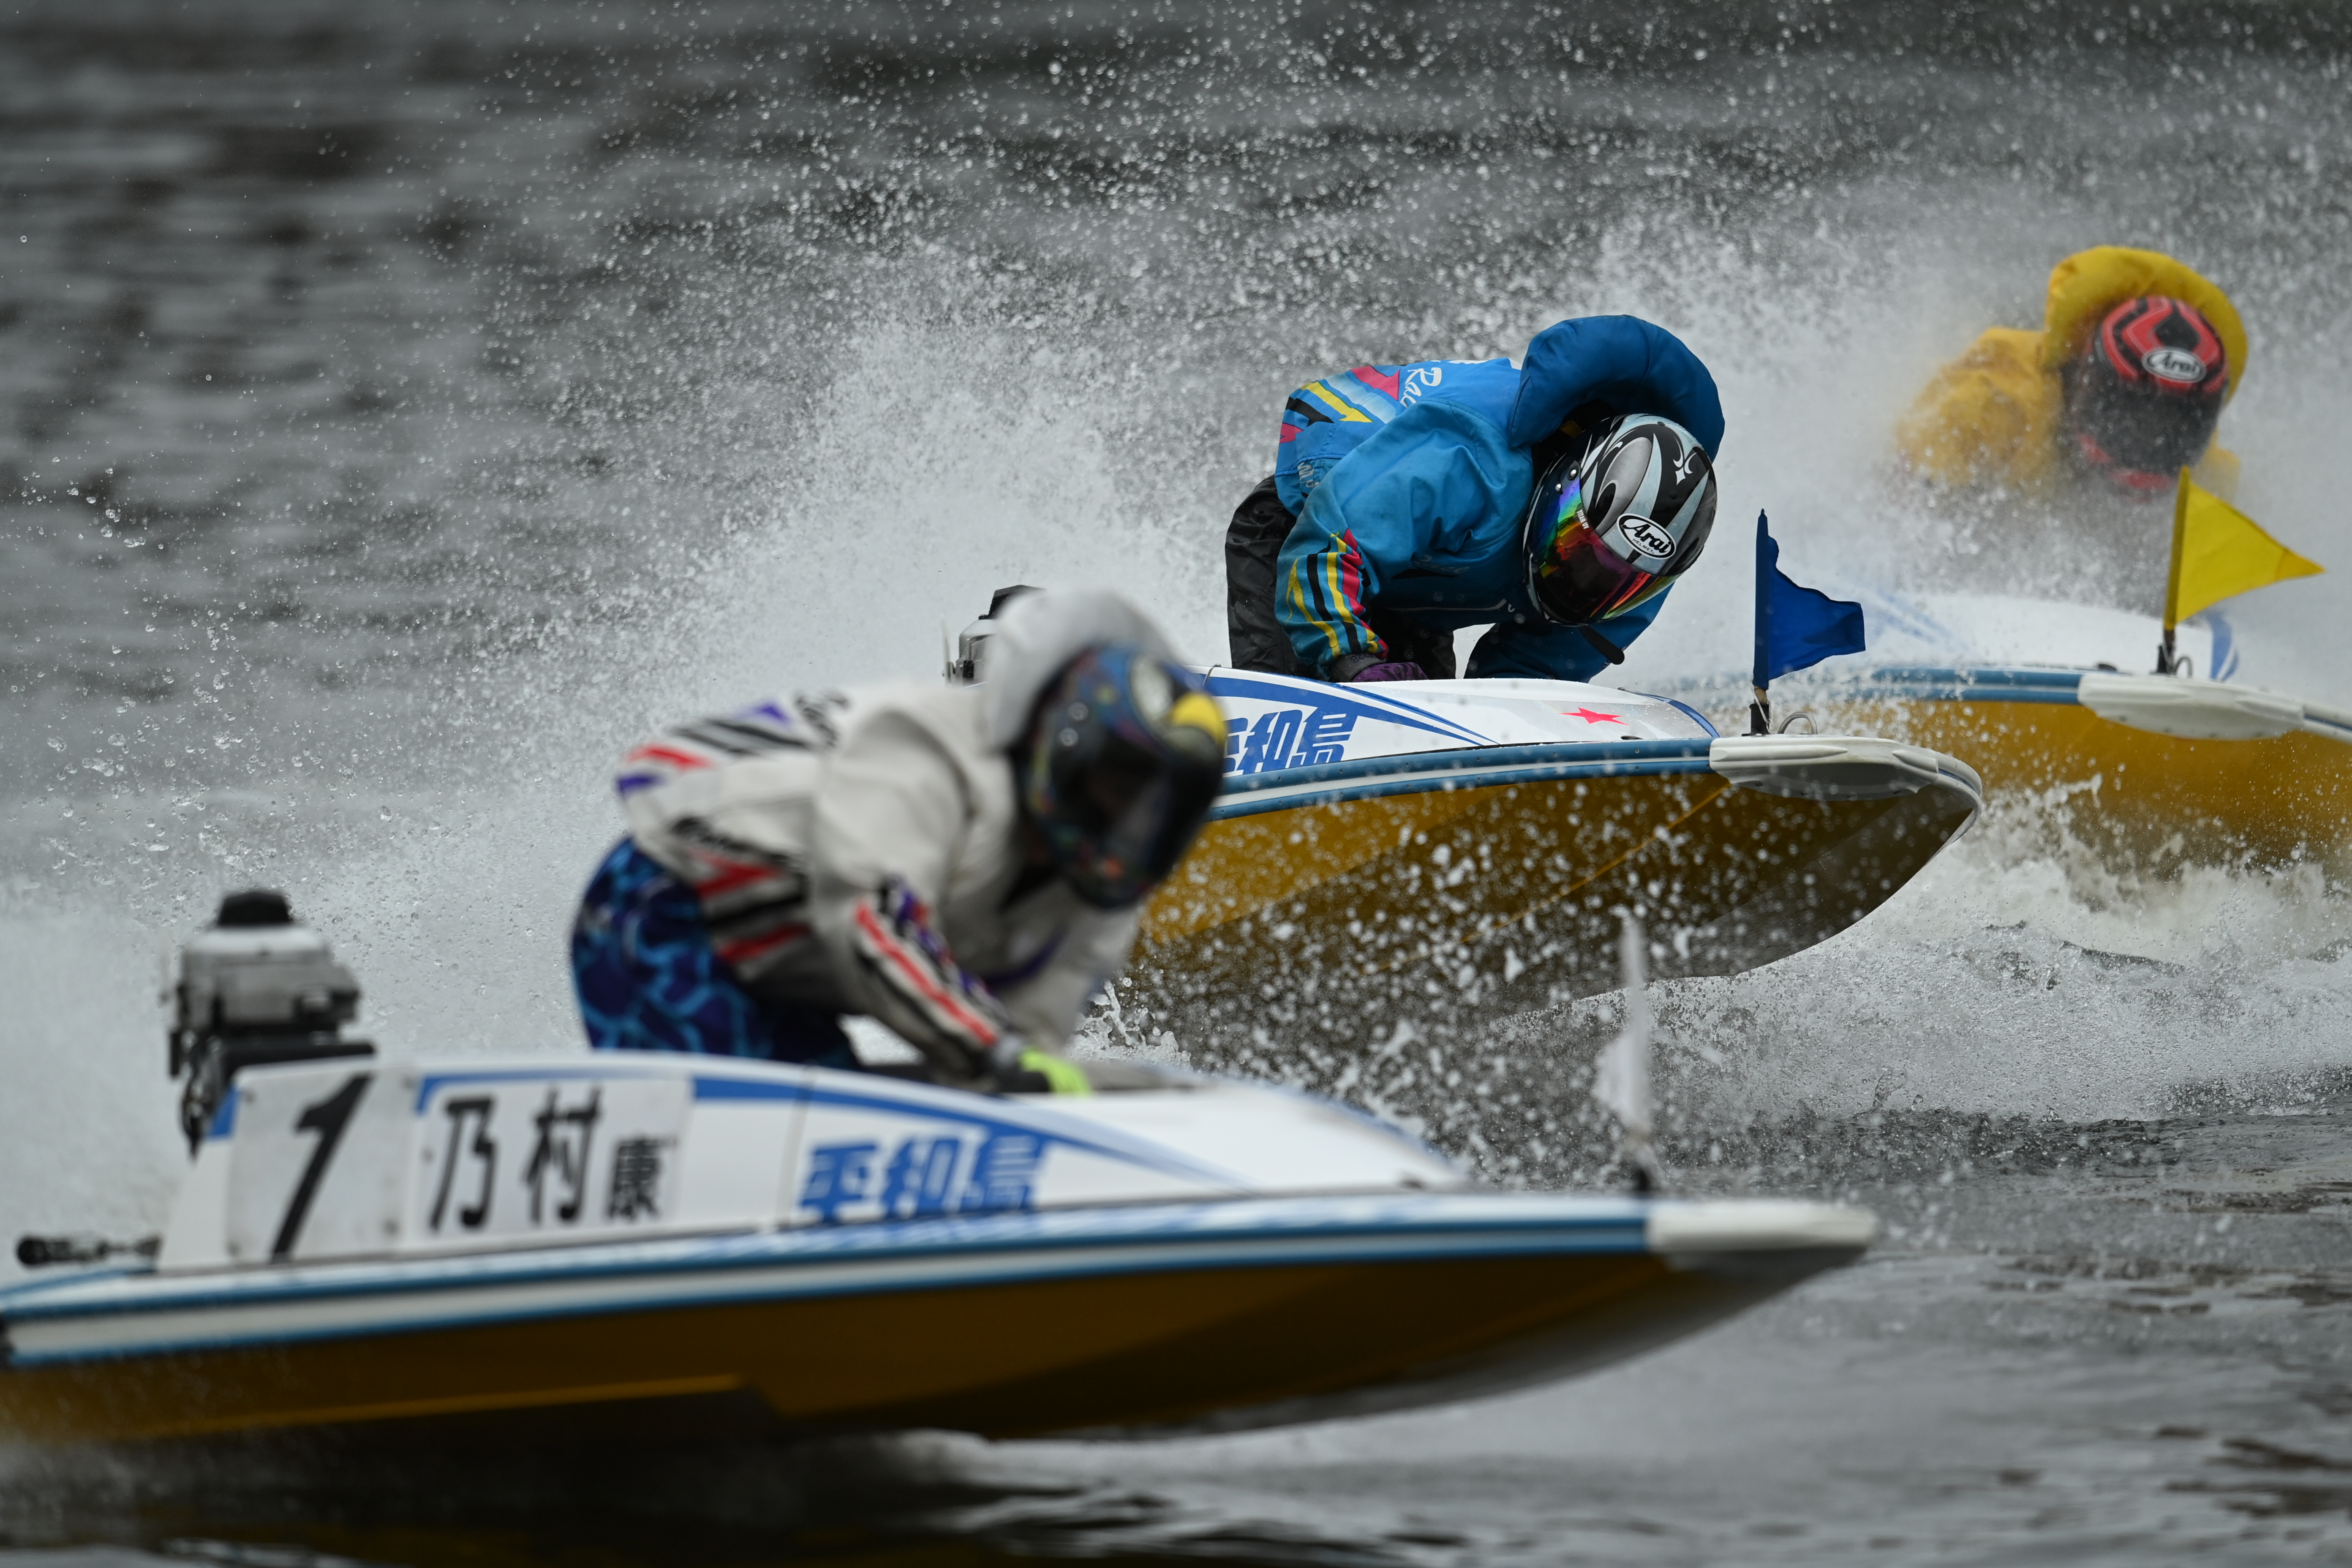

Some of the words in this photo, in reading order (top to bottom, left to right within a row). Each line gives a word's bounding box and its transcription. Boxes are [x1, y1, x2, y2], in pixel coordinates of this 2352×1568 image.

[2151, 352, 2200, 373] Arai
[1400, 367, 1442, 408] Rac
[1576, 509, 1587, 524] TITAN
[1582, 521, 1590, 530] UV
[1620, 523, 1672, 553] Arai
[1632, 538, 1653, 554] HELMET
[270, 1072, 373, 1263] 1
